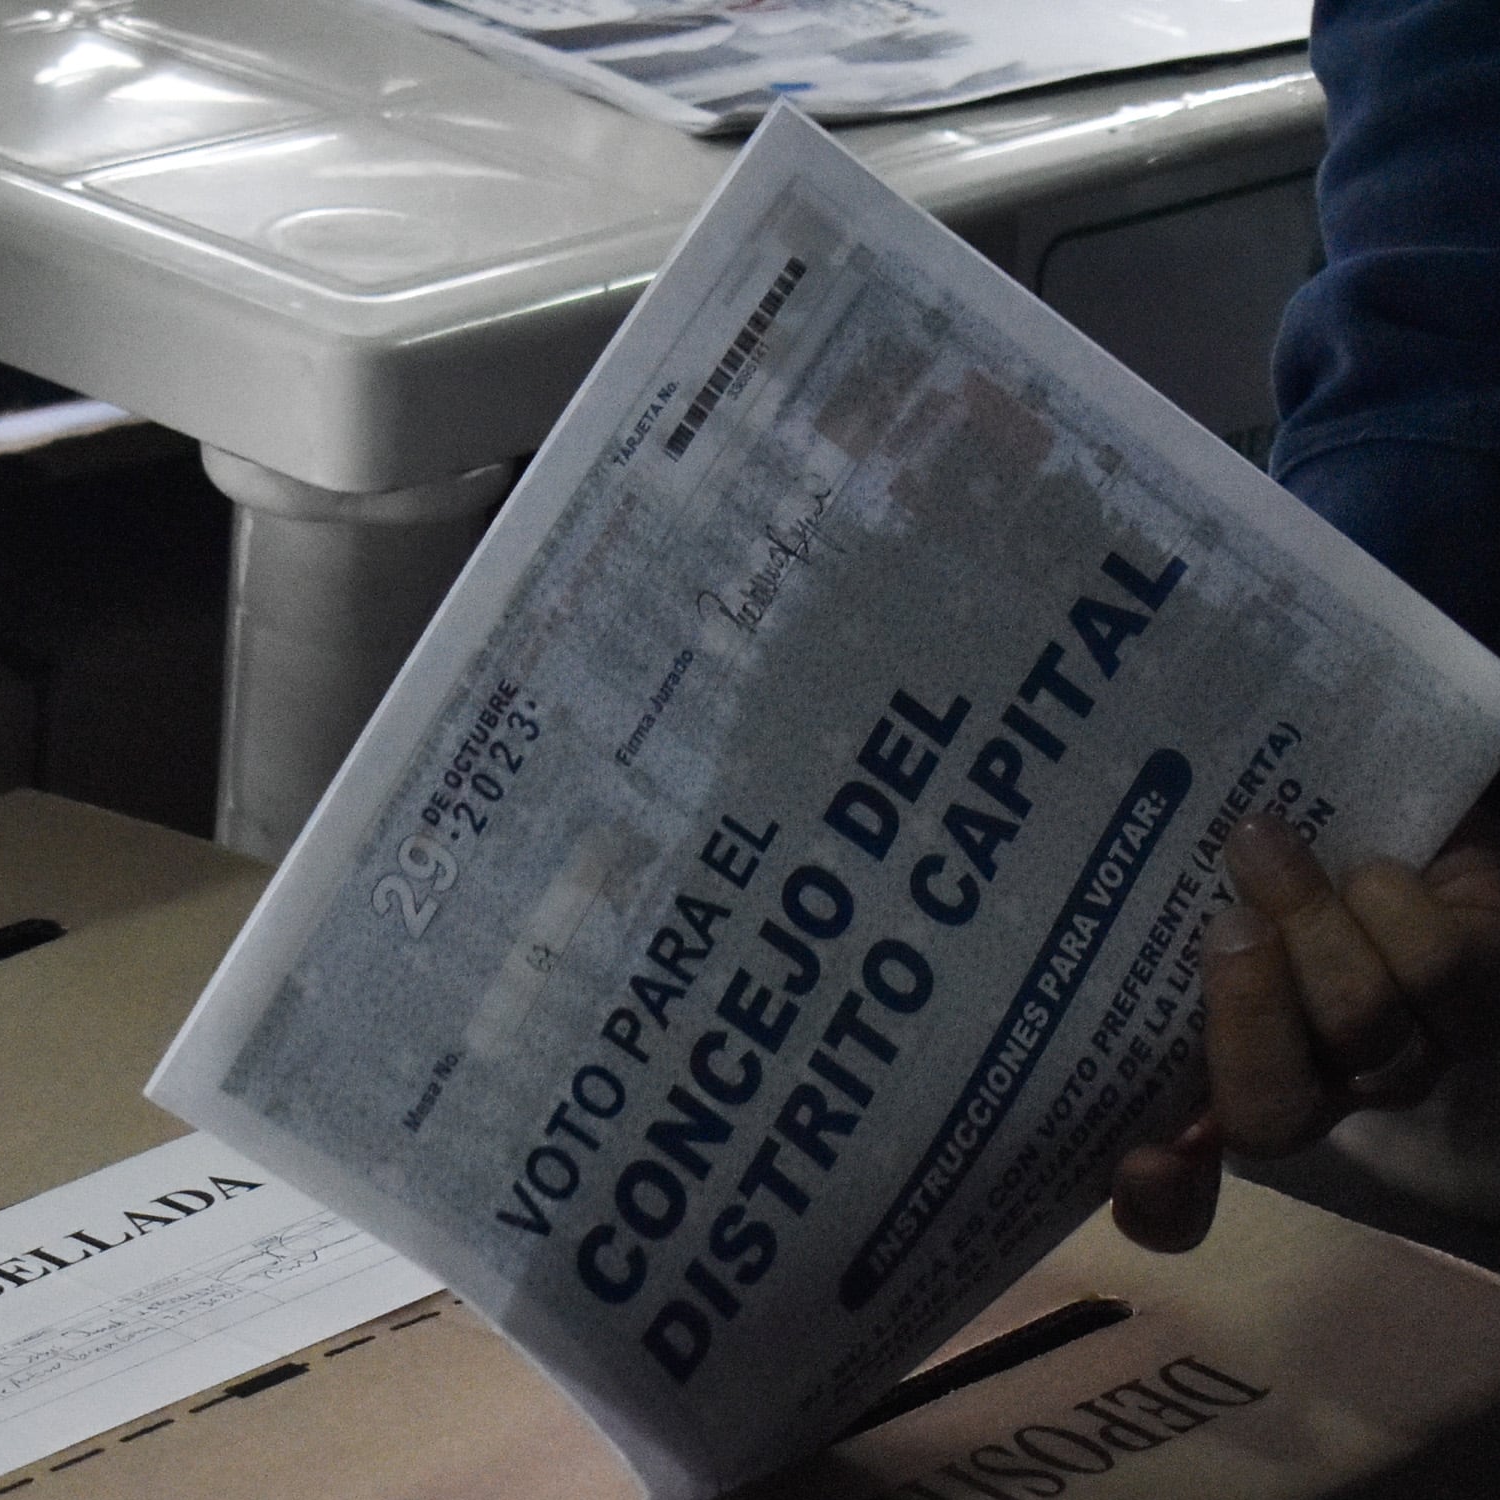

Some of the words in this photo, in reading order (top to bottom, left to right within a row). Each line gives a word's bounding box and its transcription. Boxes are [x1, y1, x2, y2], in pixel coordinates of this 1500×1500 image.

[613, 399, 663, 467] TARJETA
[371, 833, 460, 938] 29
[423, 793, 449, 827] DE
[444, 679, 519, 790] OCTUBRE
[615, 713, 656, 767] Firma
[650, 649, 694, 714] Jurado
[403, 1077, 445, 1134] Mesa
[496, 1063, 627, 1241] VOTO
[601, 902, 722, 1065] PARA
[700, 814, 780, 893] EL
[576, 865, 855, 1306] CONCEJO
[823, 688, 975, 860] DEL
[641, 935, 936, 1385] DISTRITO
[910, 553, 1190, 925] CAPITAL
[870, 1000, 1050, 1278] INSTRUCCIONES
[1037, 905, 1102, 1000] PARA
[1097, 788, 1168, 918] VOTAR:
[952, 1214, 989, 1255] ES
[989, 1140, 1041, 1209] CON
[1037, 1055, 1098, 1137] VOTO
[1091, 871, 1202, 1056] PREFERENTE
[1190, 720, 1302, 874] (ABIERTA)
[1117, 1035, 1152, 1077] DE
[1145, 994, 1179, 1037] LA
